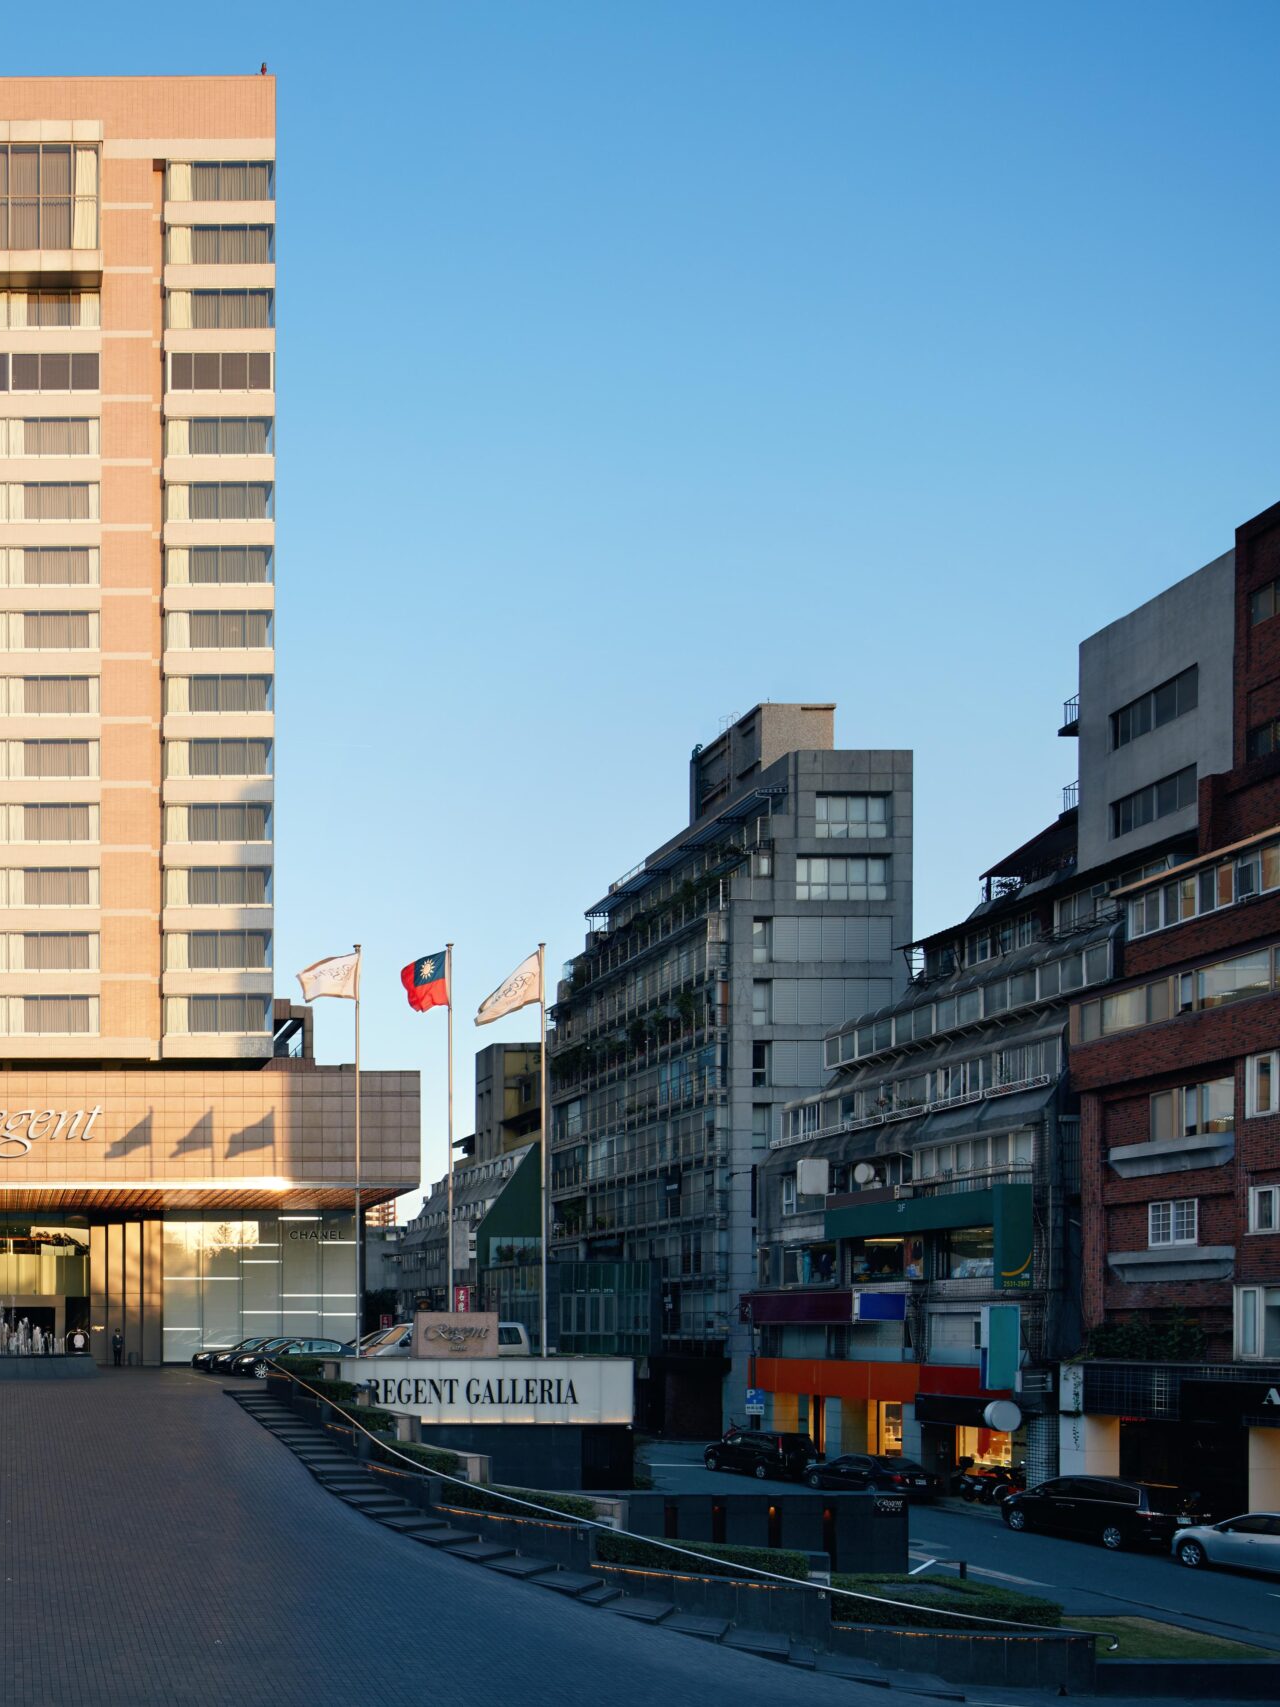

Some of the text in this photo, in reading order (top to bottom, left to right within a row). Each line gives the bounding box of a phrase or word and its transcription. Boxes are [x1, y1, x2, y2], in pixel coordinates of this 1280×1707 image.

[289, 1230, 345, 1240] CHANEL
[465, 1378, 578, 1405] GALLERIA
[746, 1389, 756, 1399] P
